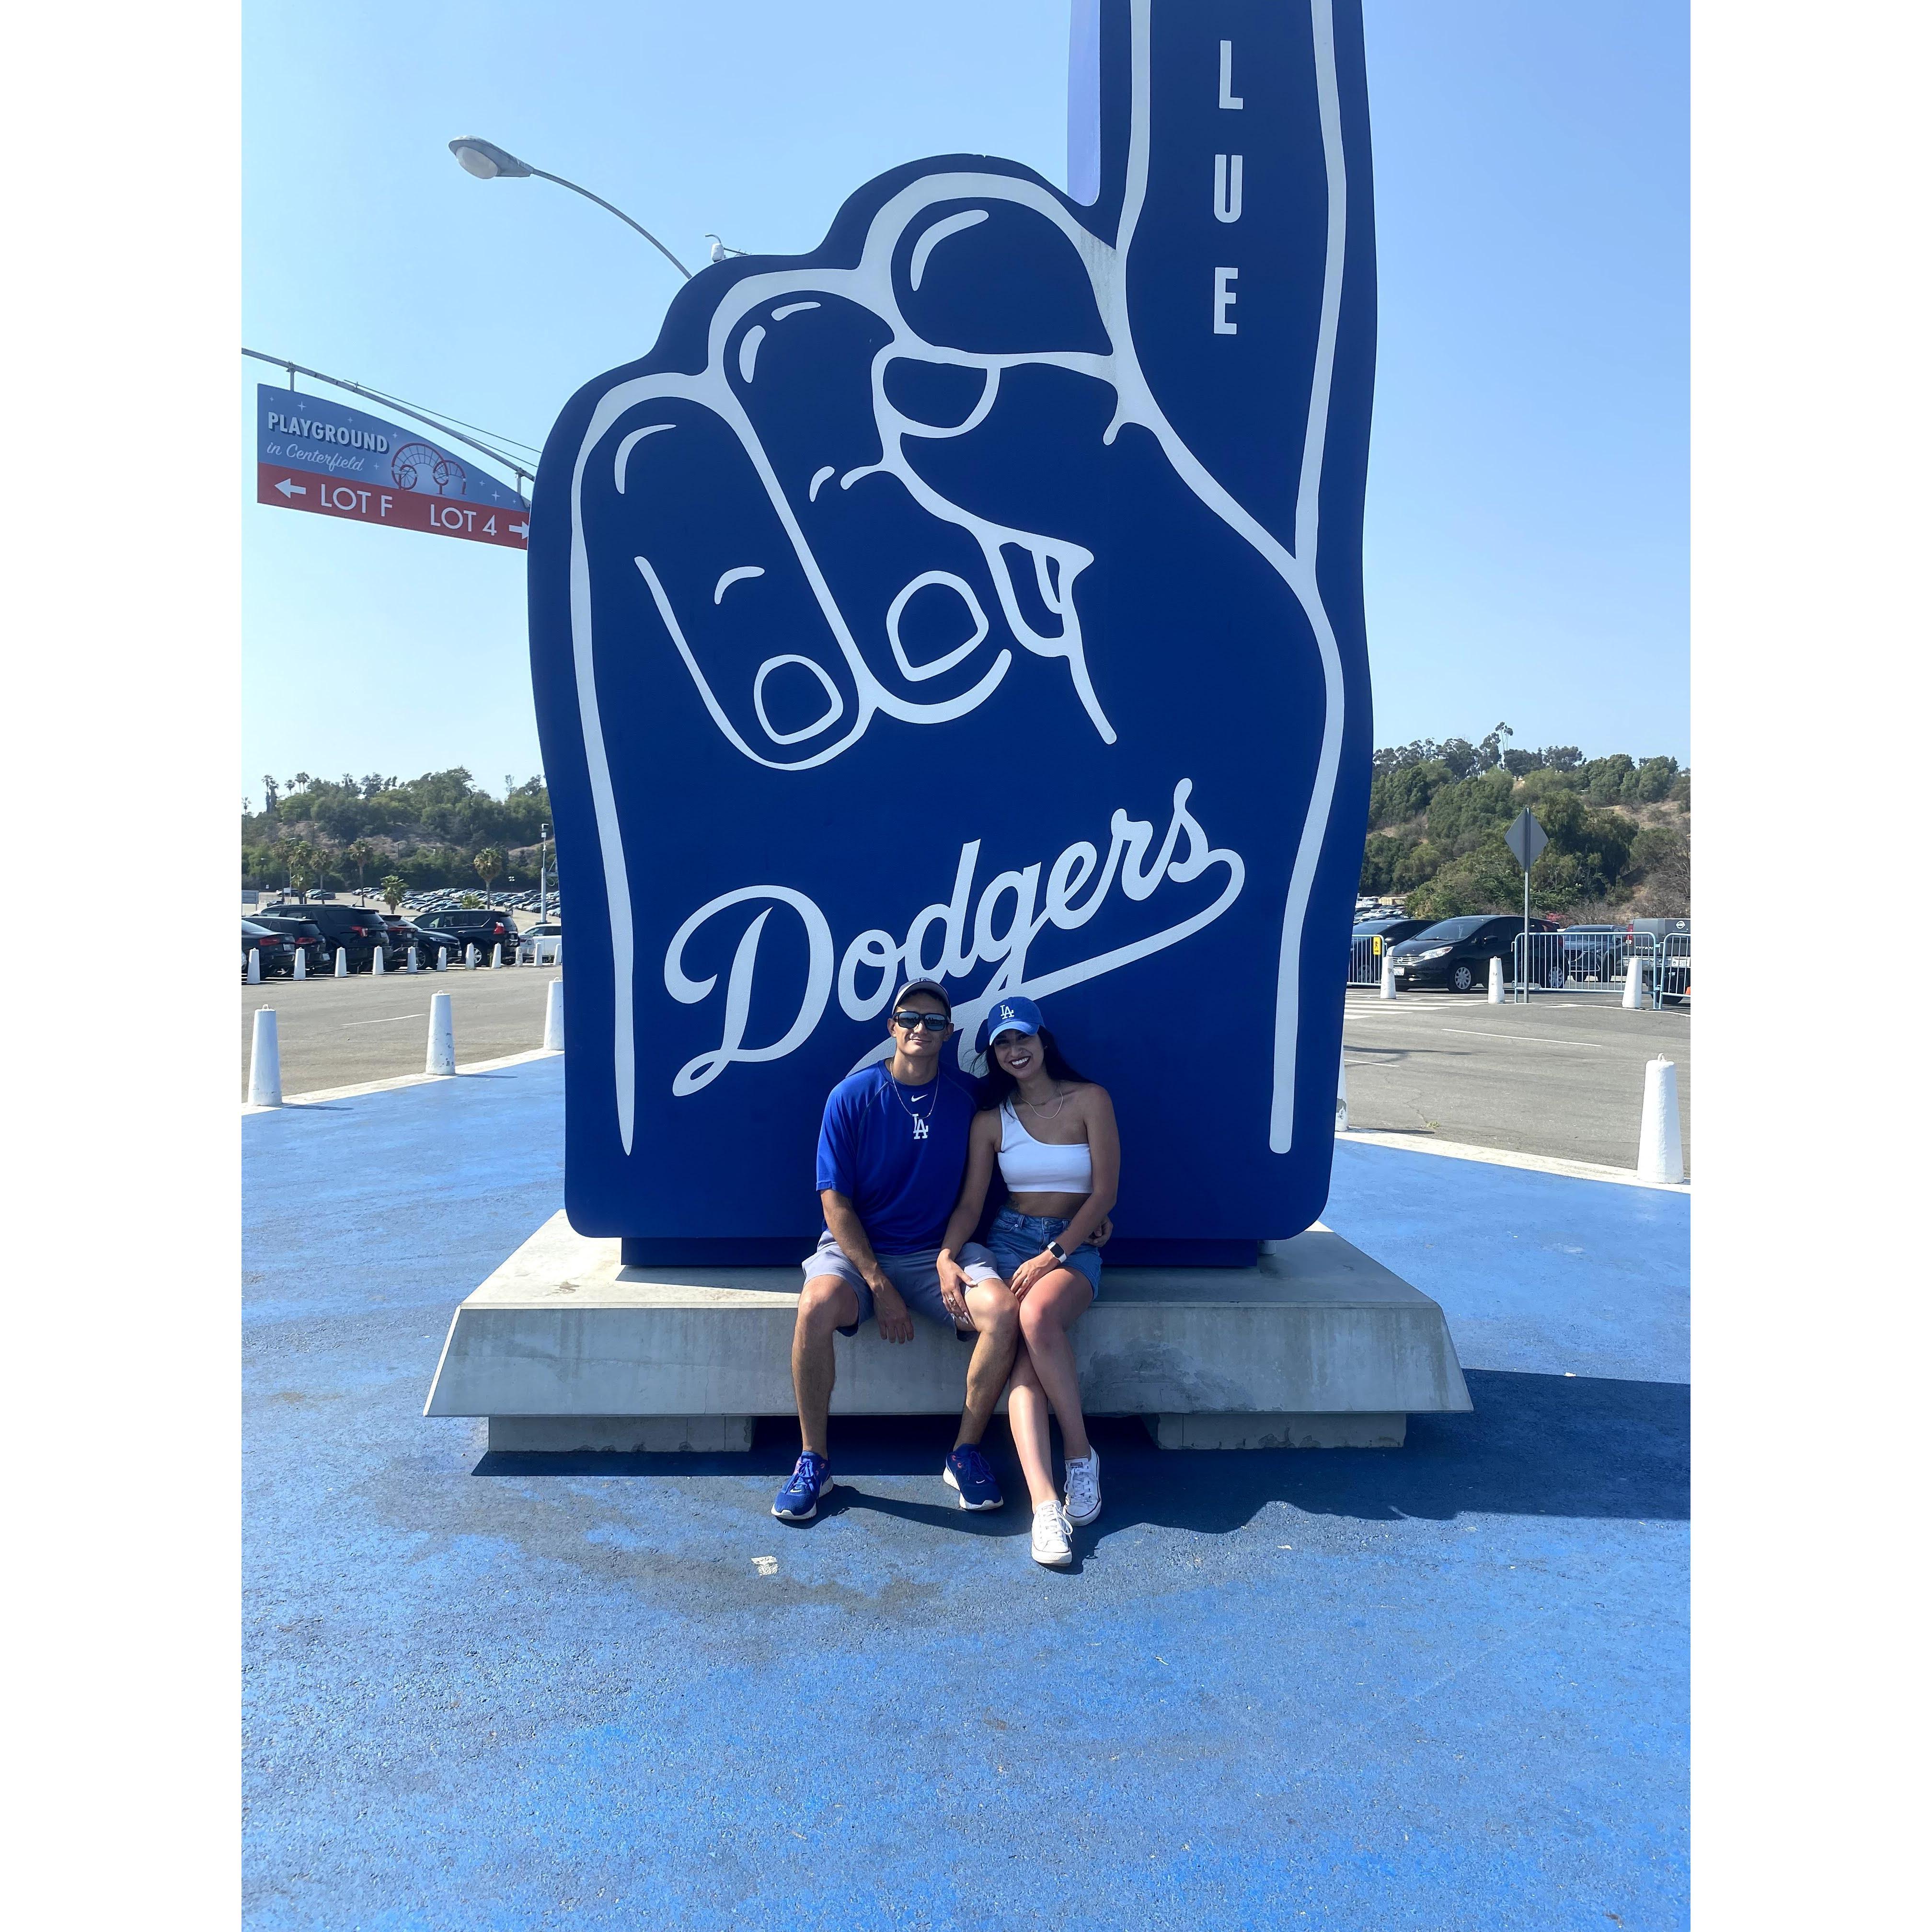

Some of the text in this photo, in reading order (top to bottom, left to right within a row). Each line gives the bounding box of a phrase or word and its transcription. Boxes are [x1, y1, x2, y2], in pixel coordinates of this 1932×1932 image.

[268, 411, 389, 453] PLAYGROUND
[267, 442, 365, 472] in Centerfield
[321, 483, 392, 517] LOT F
[431, 504, 497, 536] LOT 4
[664, 778, 1245, 1097] Dodgers
[1000, 1004, 1014, 1020] LA
[912, 1113, 929, 1139] LA
